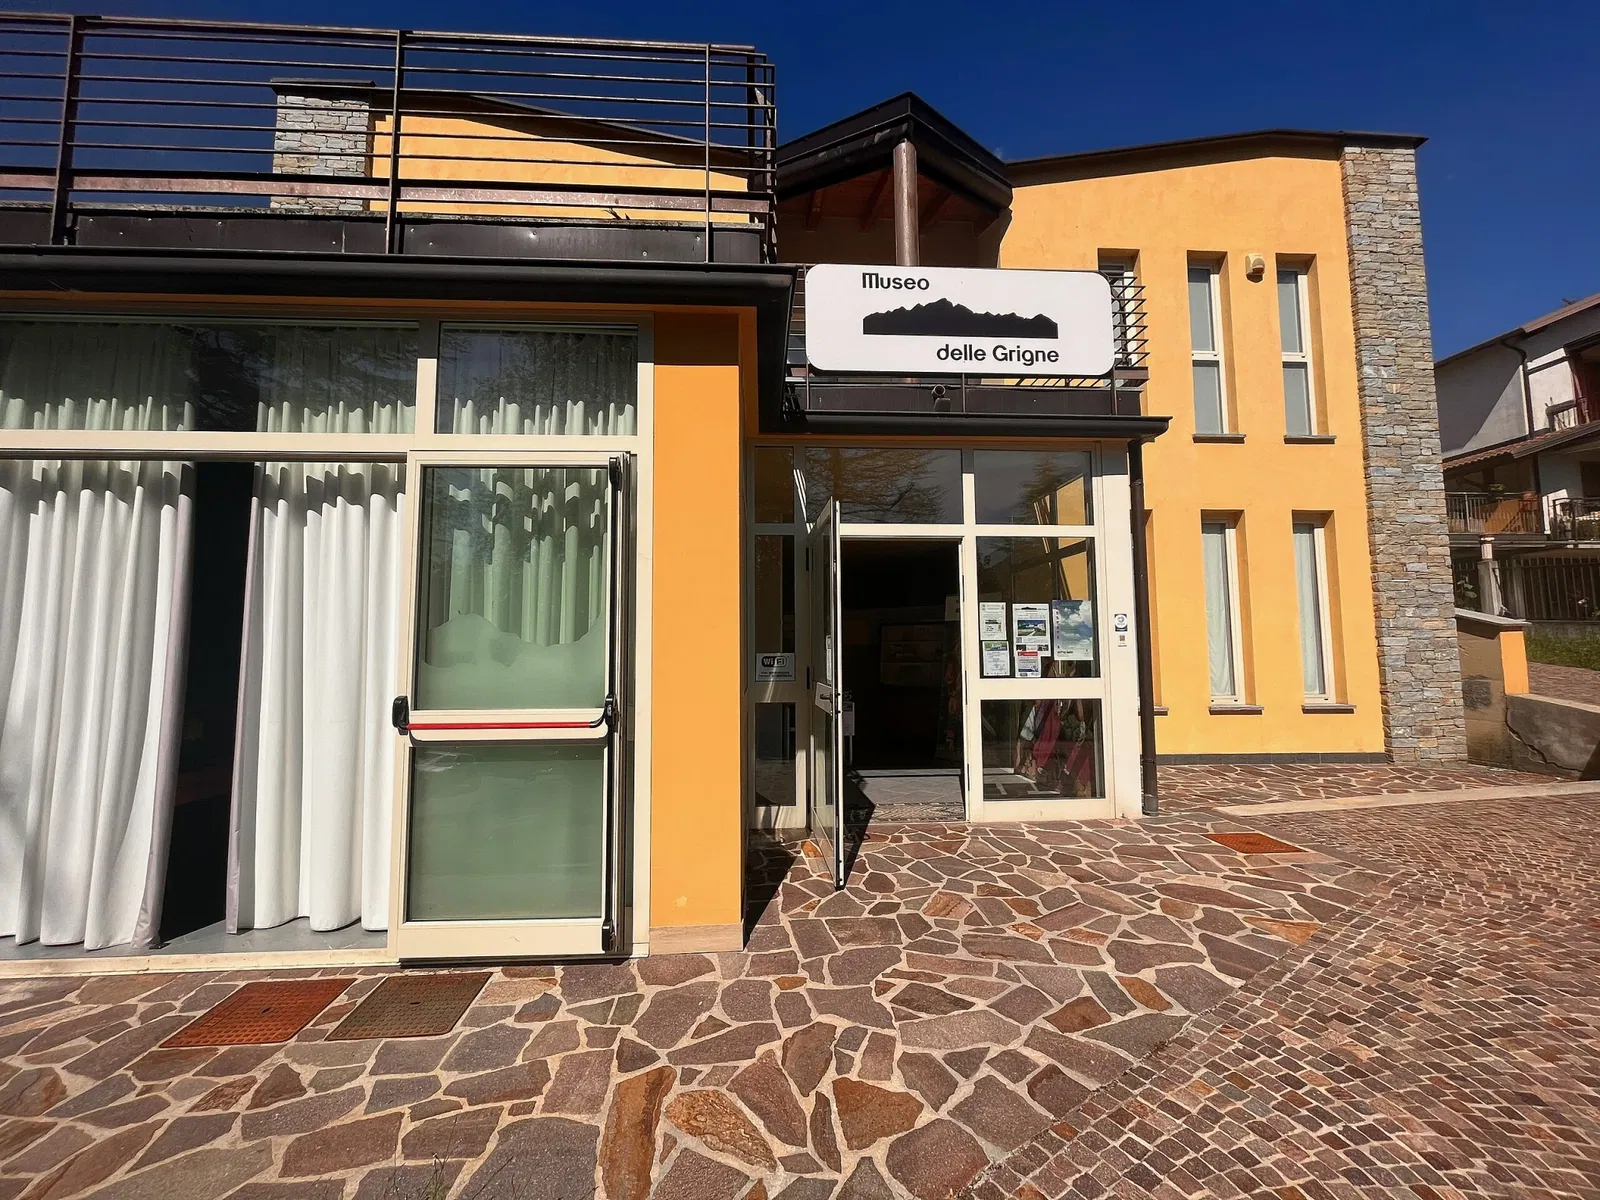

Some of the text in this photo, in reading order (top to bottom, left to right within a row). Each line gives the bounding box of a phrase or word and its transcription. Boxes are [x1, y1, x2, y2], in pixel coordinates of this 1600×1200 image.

[862, 273, 930, 291] Museo
[936, 344, 1060, 367] delle Grigne
